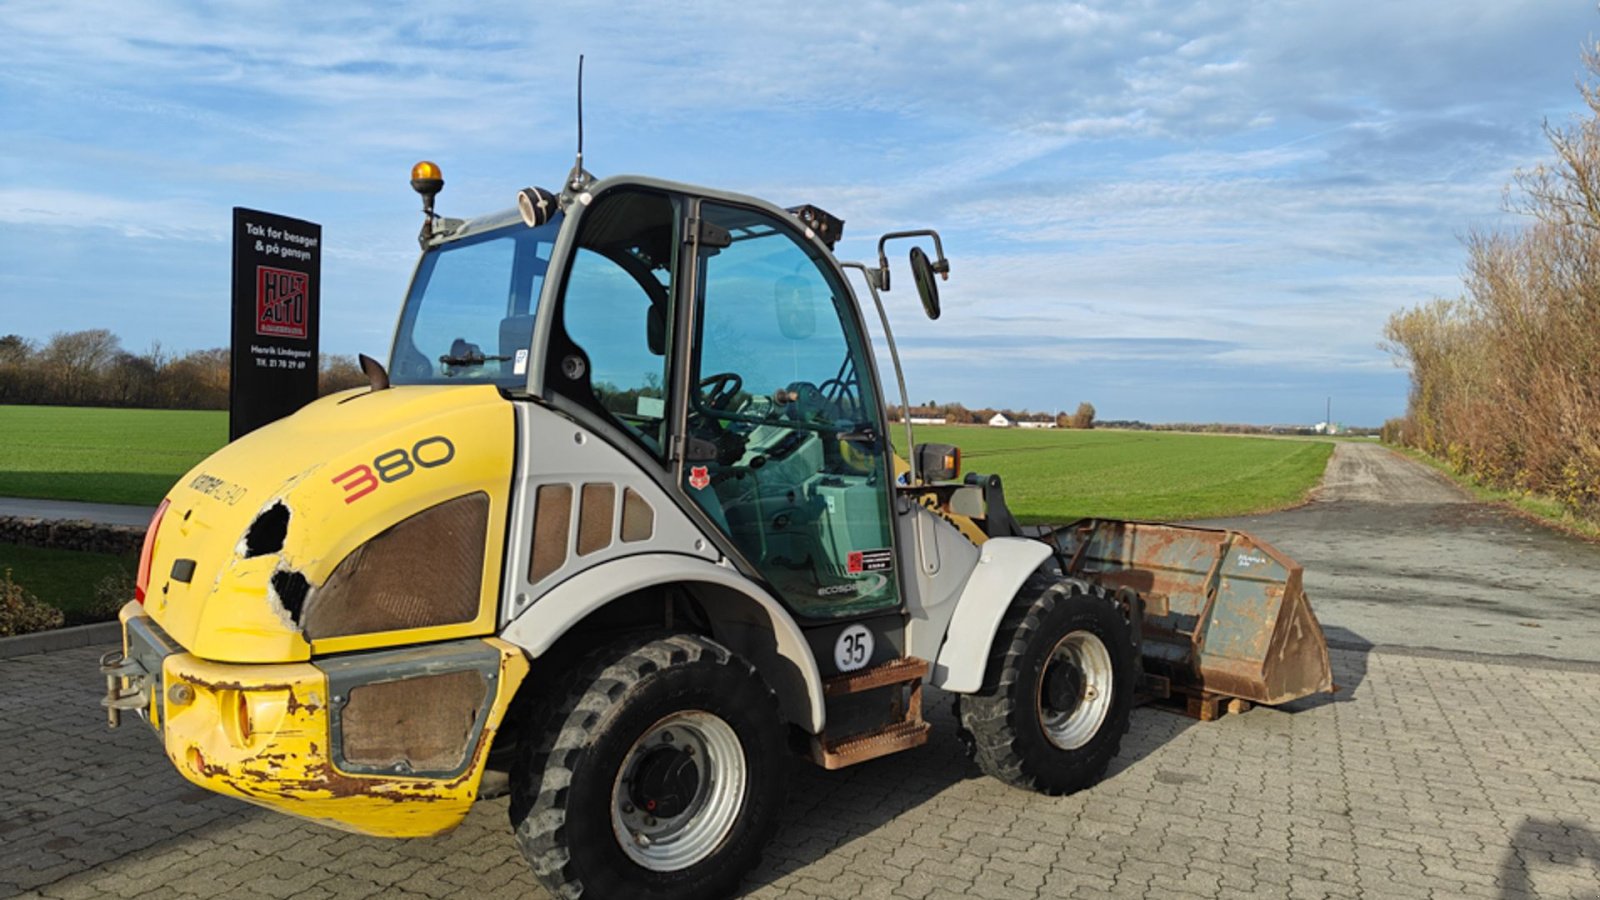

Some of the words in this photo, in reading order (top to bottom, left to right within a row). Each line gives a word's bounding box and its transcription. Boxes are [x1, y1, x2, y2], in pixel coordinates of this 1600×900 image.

[245, 222, 266, 237] Tak
[267, 226, 283, 239] for
[255, 240, 264, 252] &
[265, 243, 280, 255] på
[281, 247, 311, 261] gensyn
[264, 270, 305, 301] HOLT
[262, 292, 304, 324] AUTO
[250, 344, 276, 355] Henrik
[277, 359, 287, 368] 78
[332, 435, 455, 504] 380
[842, 632, 867, 666] 35
